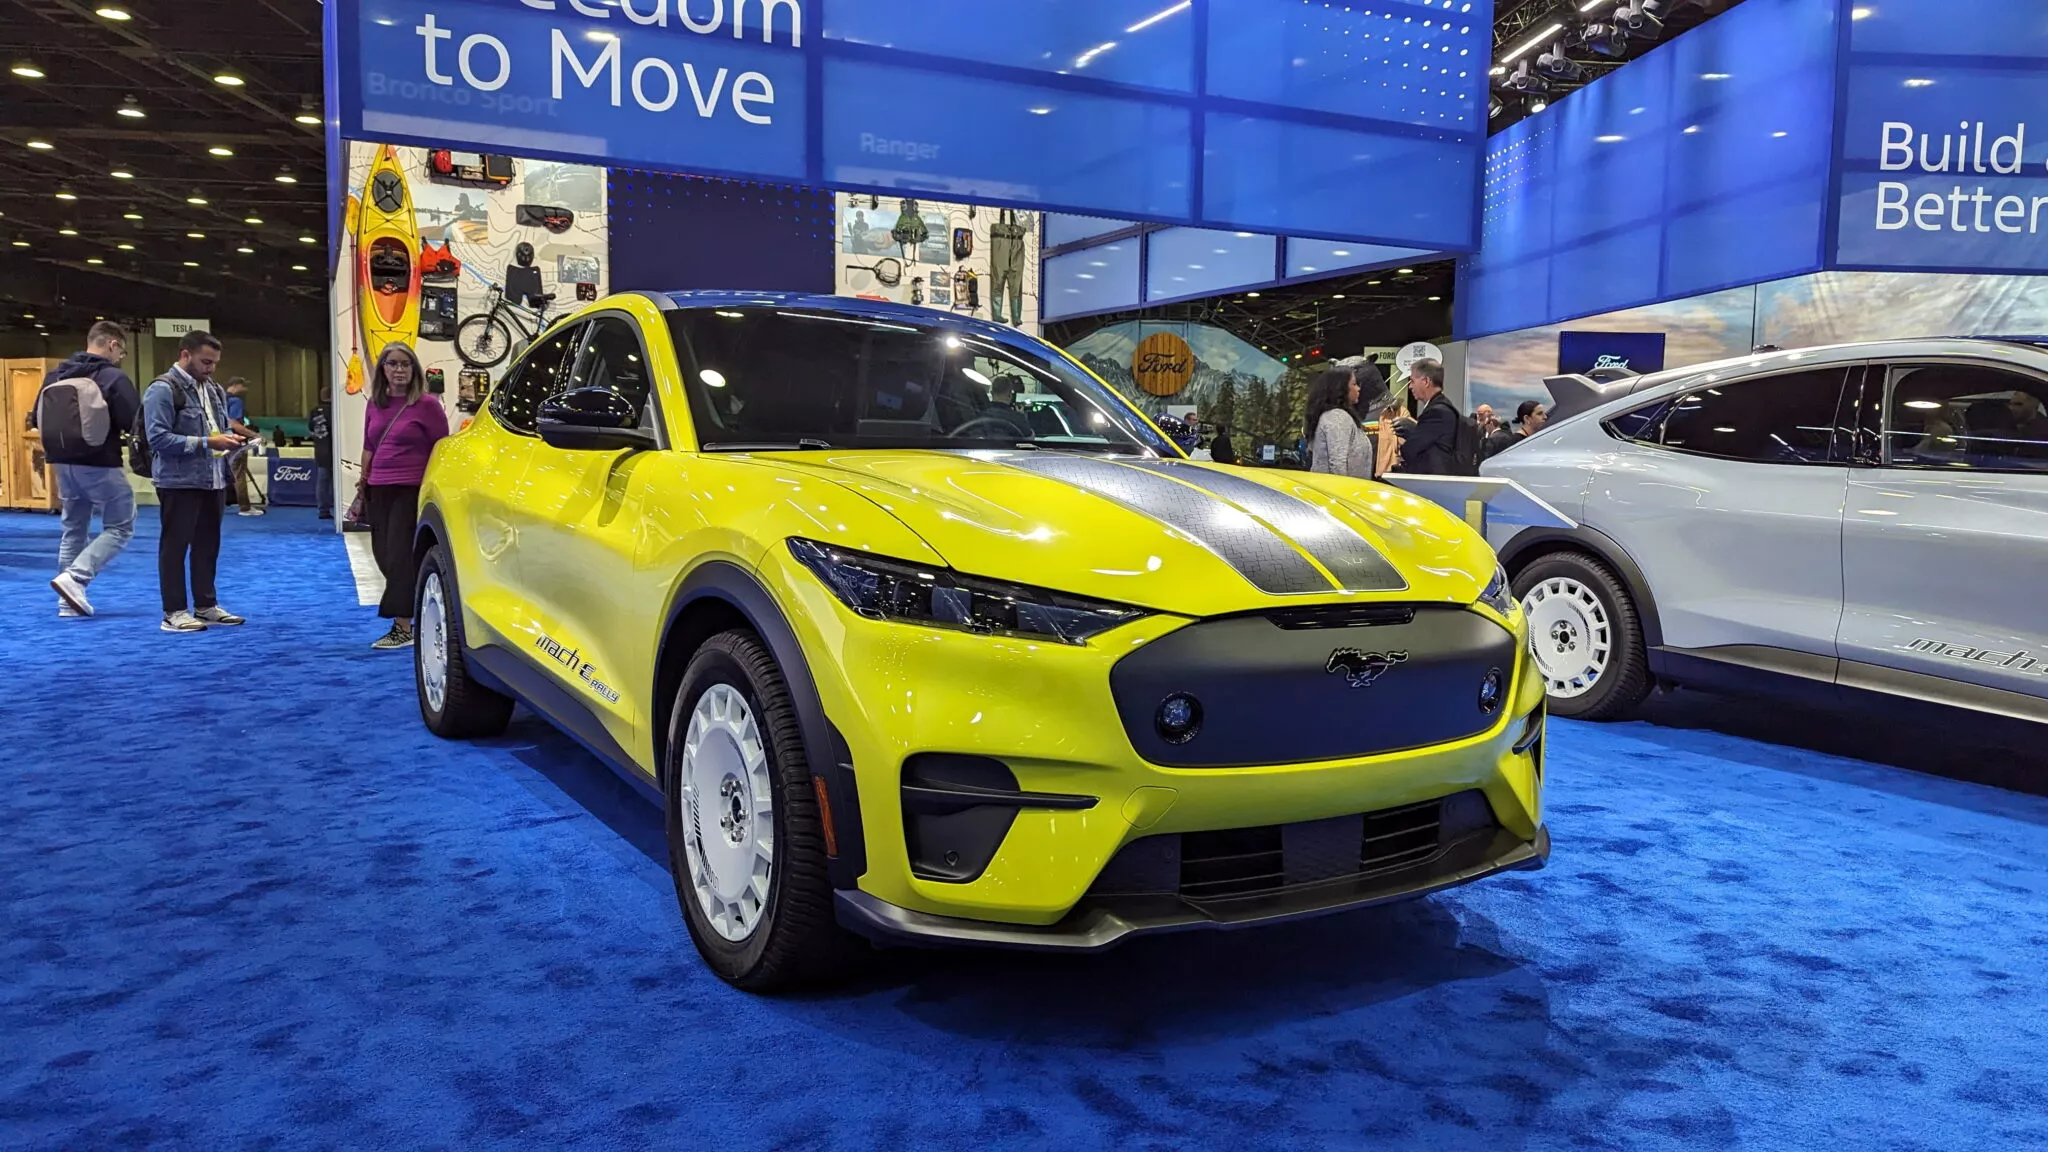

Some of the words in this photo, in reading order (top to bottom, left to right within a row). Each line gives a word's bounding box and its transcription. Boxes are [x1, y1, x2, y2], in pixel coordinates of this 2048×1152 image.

[415, 13, 511, 91] to
[552, 28, 774, 125] Move
[368, 72, 470, 105] Bronco
[480, 89, 558, 117] Sport
[860, 132, 941, 161] Ranger
[1880, 120, 2025, 174] Build
[1875, 181, 2048, 234] Better
[172, 324, 193, 333] TESLA
[1138, 352, 1188, 374] Ford
[1380, 351, 1396, 360] FORD
[1594, 354, 1630, 369] Ford
[273, 465, 312, 482] Ford
[590, 680, 619, 703] RALLY
